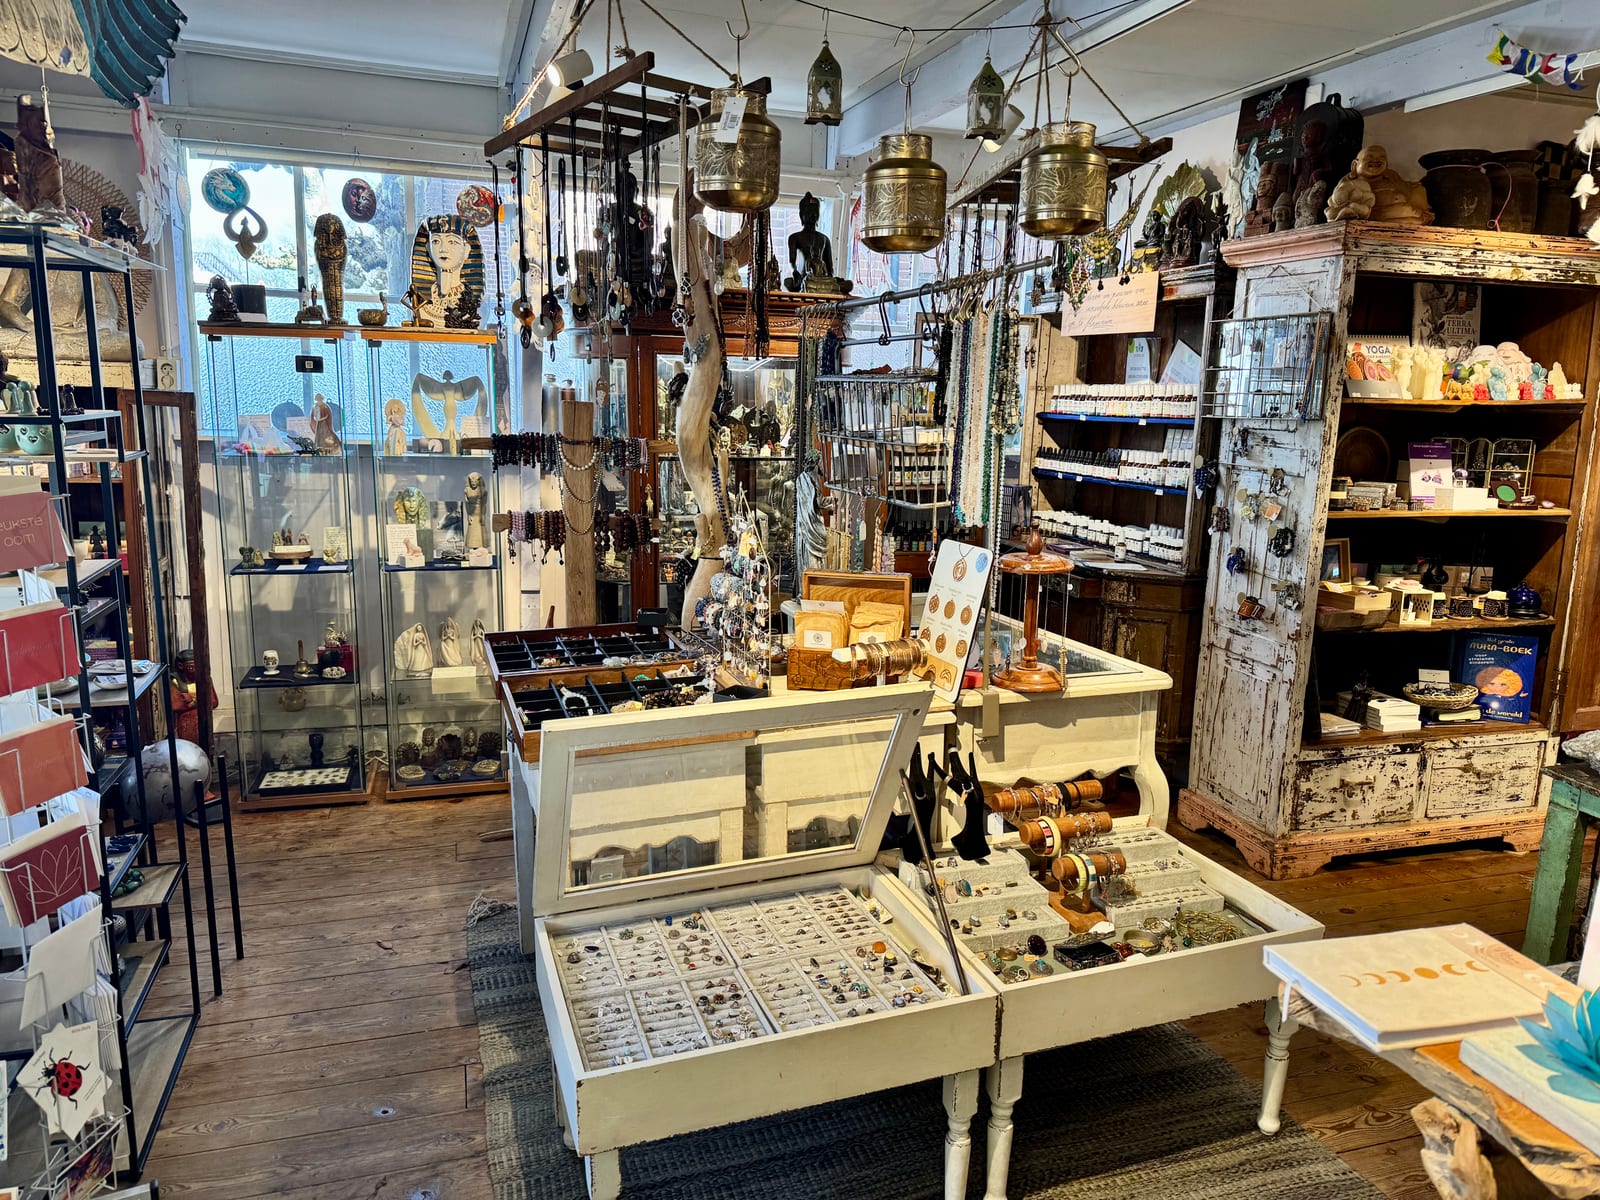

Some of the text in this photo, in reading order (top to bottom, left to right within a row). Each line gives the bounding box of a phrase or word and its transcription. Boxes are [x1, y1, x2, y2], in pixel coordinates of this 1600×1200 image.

[1446, 319, 1471, 327] TERRA
[1446, 327, 1476, 335] ULTIMA
[1365, 345, 1391, 354] YOGA
